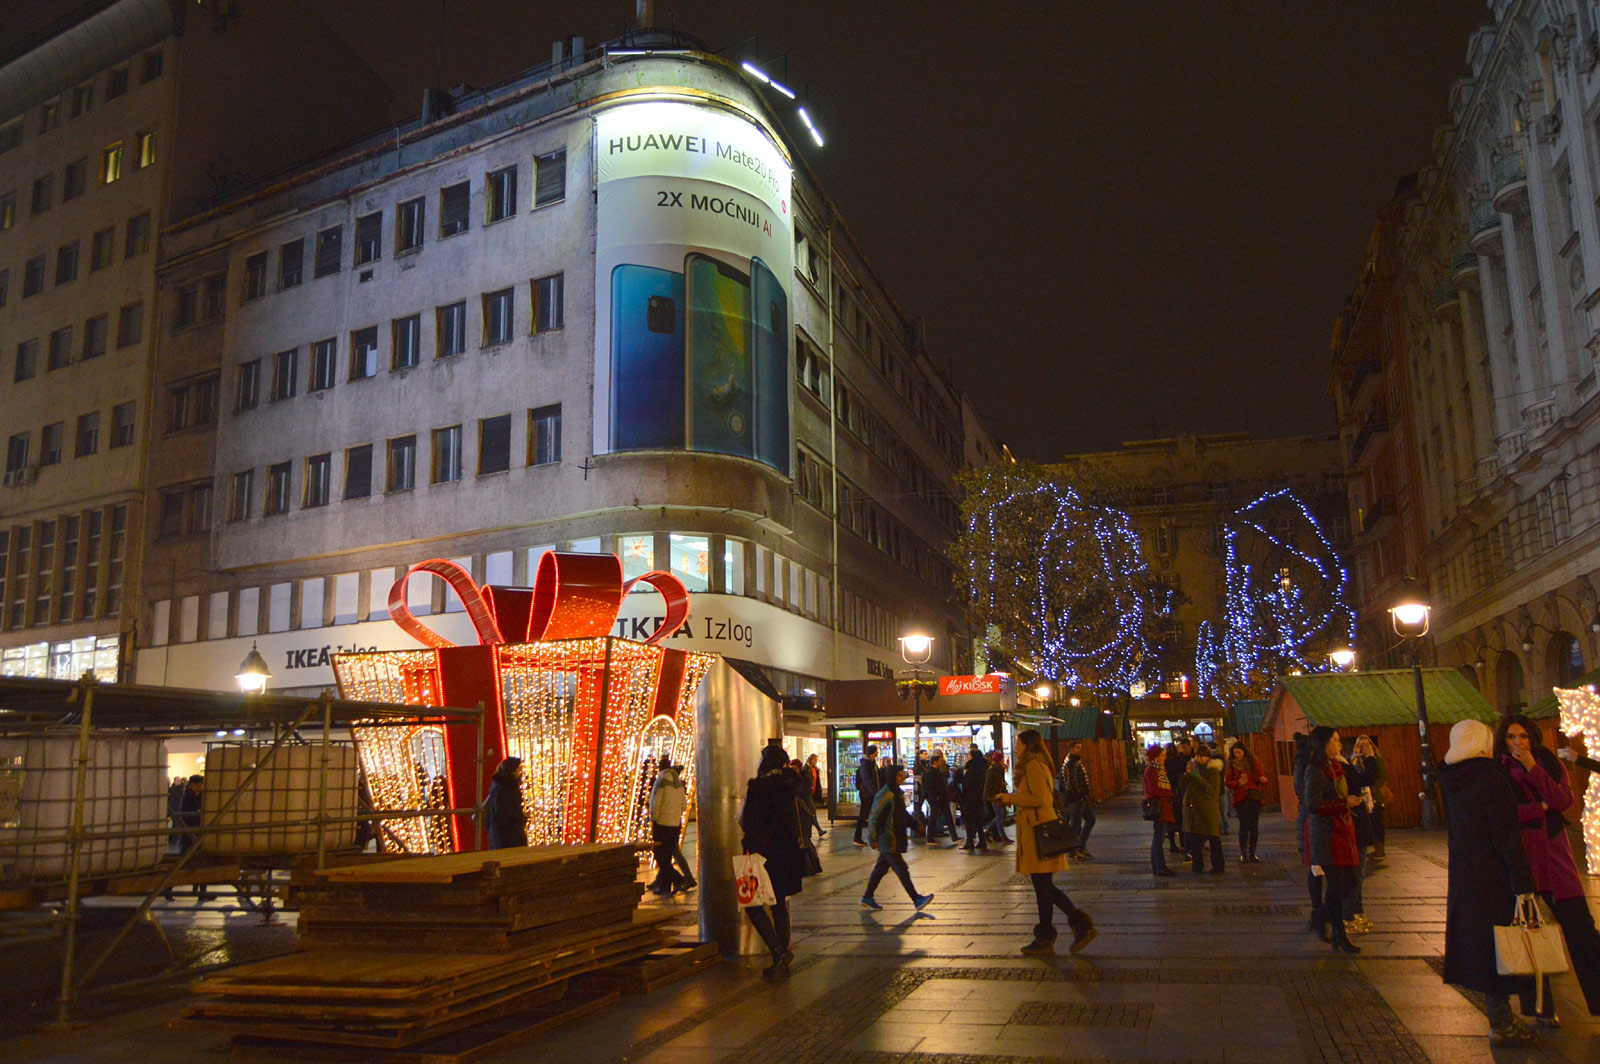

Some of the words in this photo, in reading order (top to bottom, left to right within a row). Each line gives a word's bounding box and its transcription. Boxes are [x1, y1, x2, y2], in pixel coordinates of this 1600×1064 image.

[609, 133, 706, 155] HUAWEI
[716, 140, 766, 179] Mate20
[768, 168, 780, 193] Pro
[657, 191, 683, 208] 2X
[691, 193, 760, 228] MOĆNIJI
[763, 219, 772, 238] AI
[704, 617, 753, 648] Izlog
[285, 646, 331, 670] IKEA
[946, 679, 963, 693] Moj
